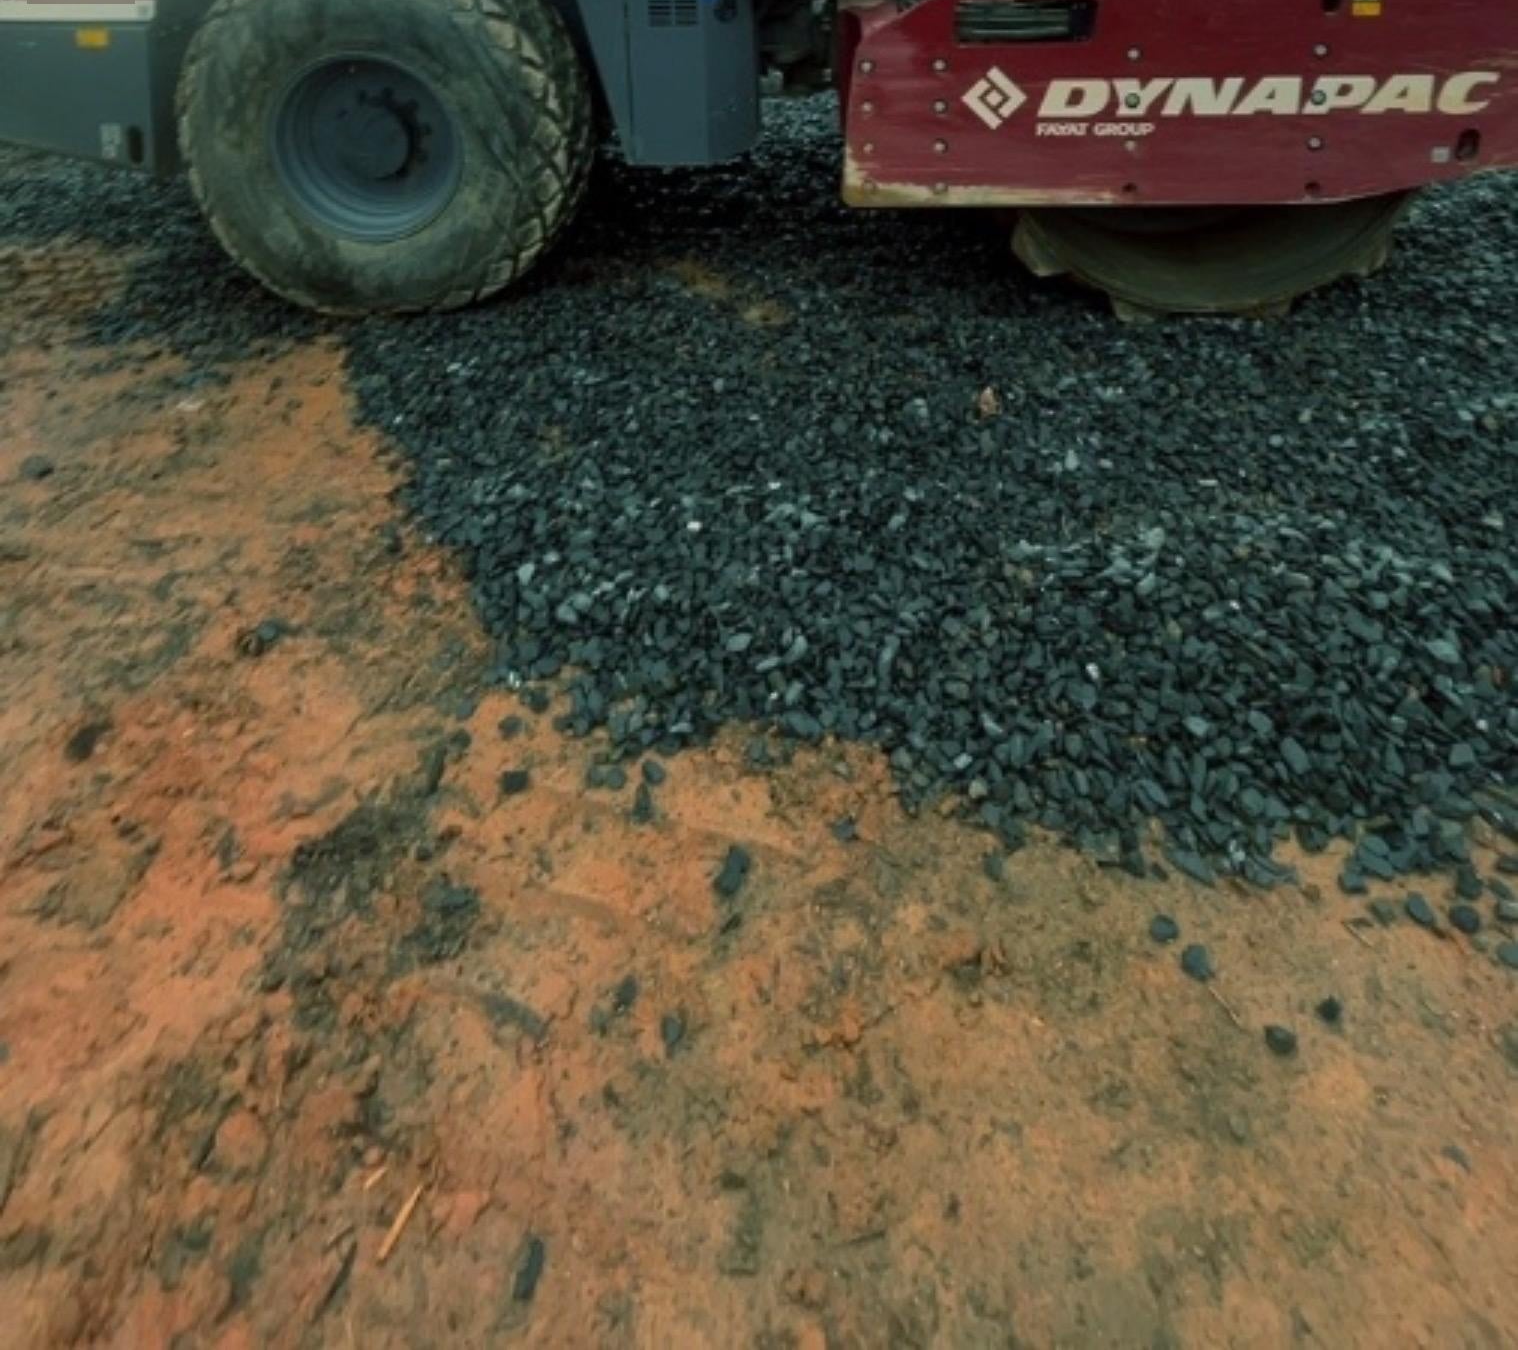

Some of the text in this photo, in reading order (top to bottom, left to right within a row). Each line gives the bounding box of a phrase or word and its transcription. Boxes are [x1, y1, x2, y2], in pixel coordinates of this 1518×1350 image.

[1037, 72, 1500, 117] DYNAPAC
[1036, 122, 1155, 136] FAYAT GROUP
